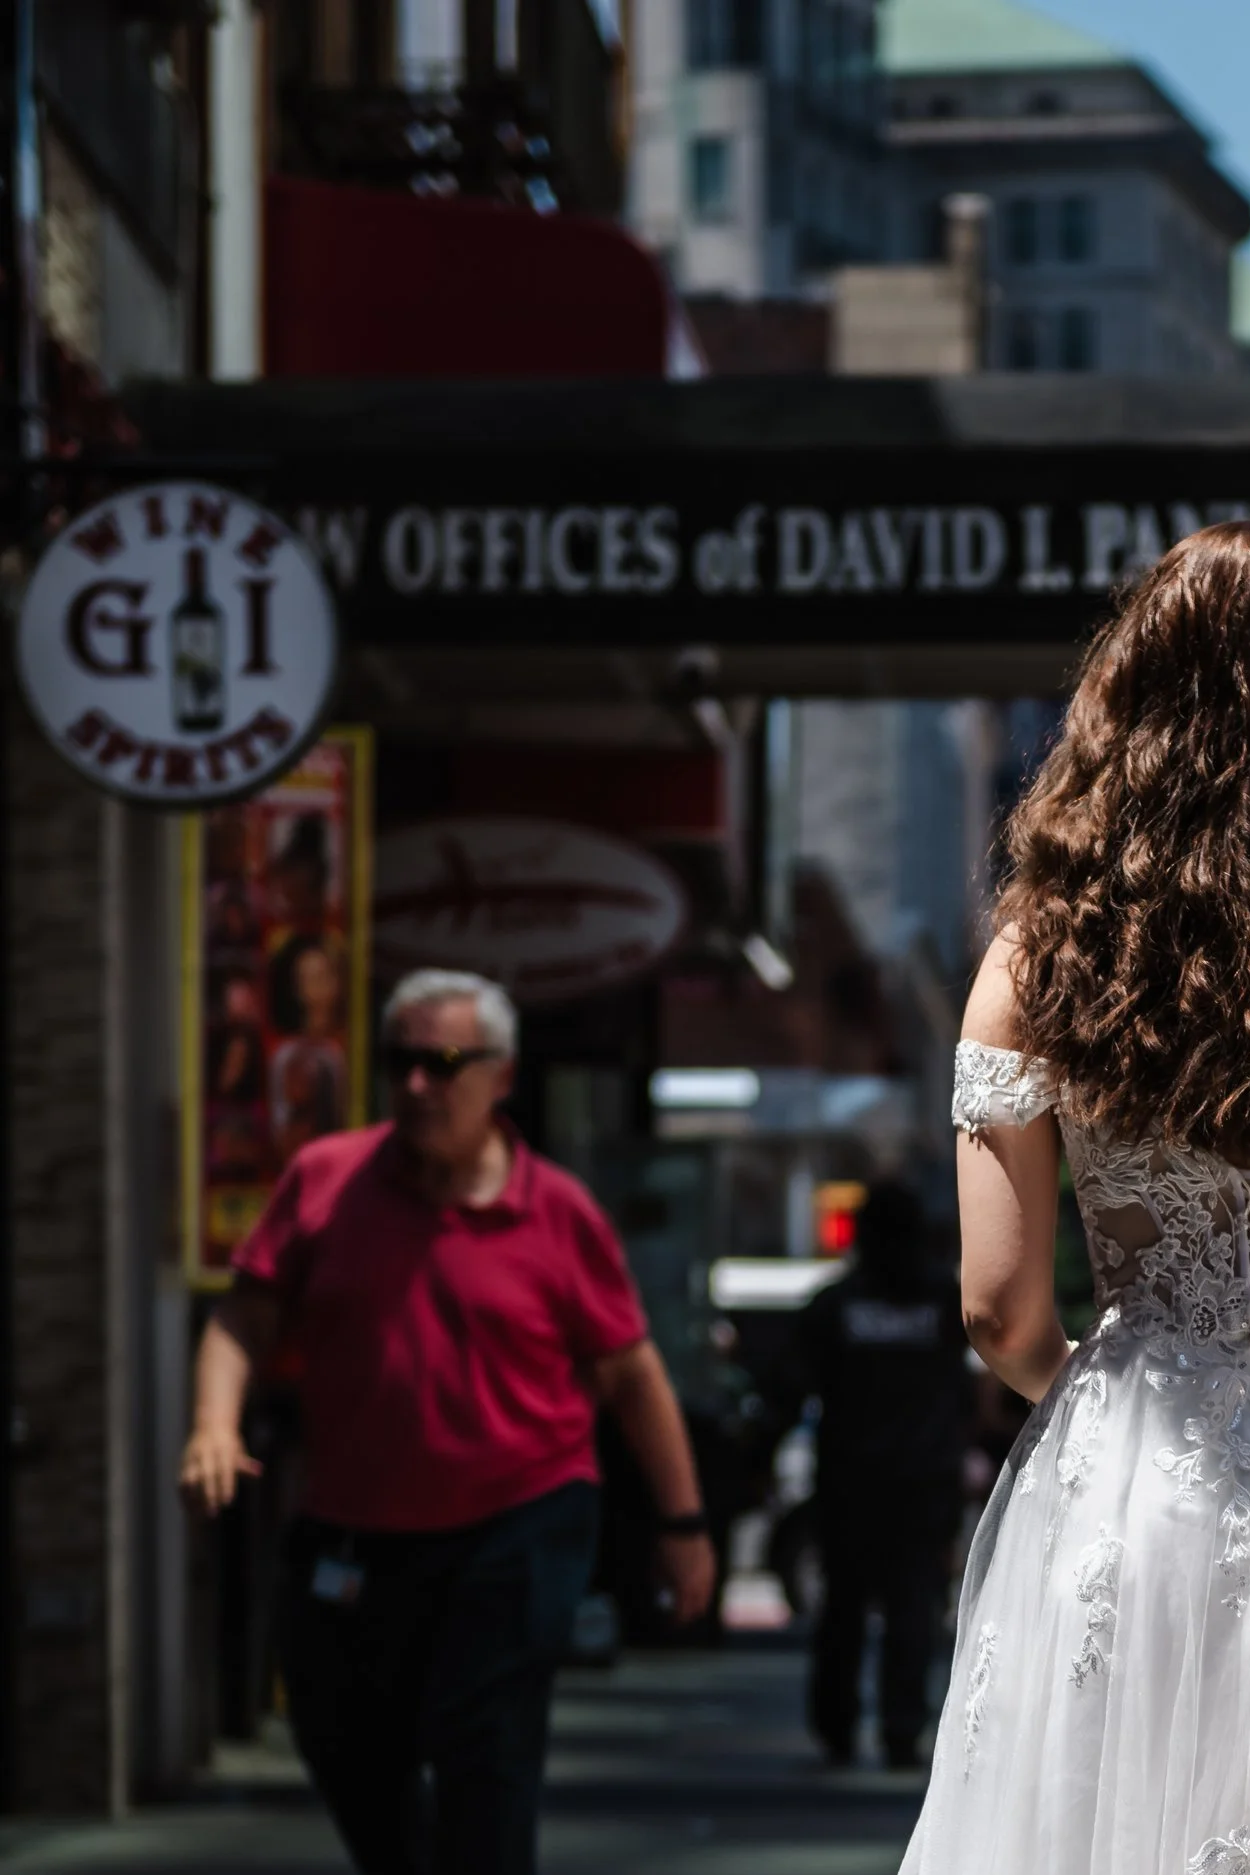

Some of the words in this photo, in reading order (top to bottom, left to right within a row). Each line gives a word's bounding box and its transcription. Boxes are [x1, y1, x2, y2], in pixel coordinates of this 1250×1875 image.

[71, 496, 284, 565] WINE
[383, 502, 682, 595] OFFICES
[693, 503, 769, 596] of
[778, 505, 1010, 594] DAVID
[70, 708, 295, 787] SPIRITS
